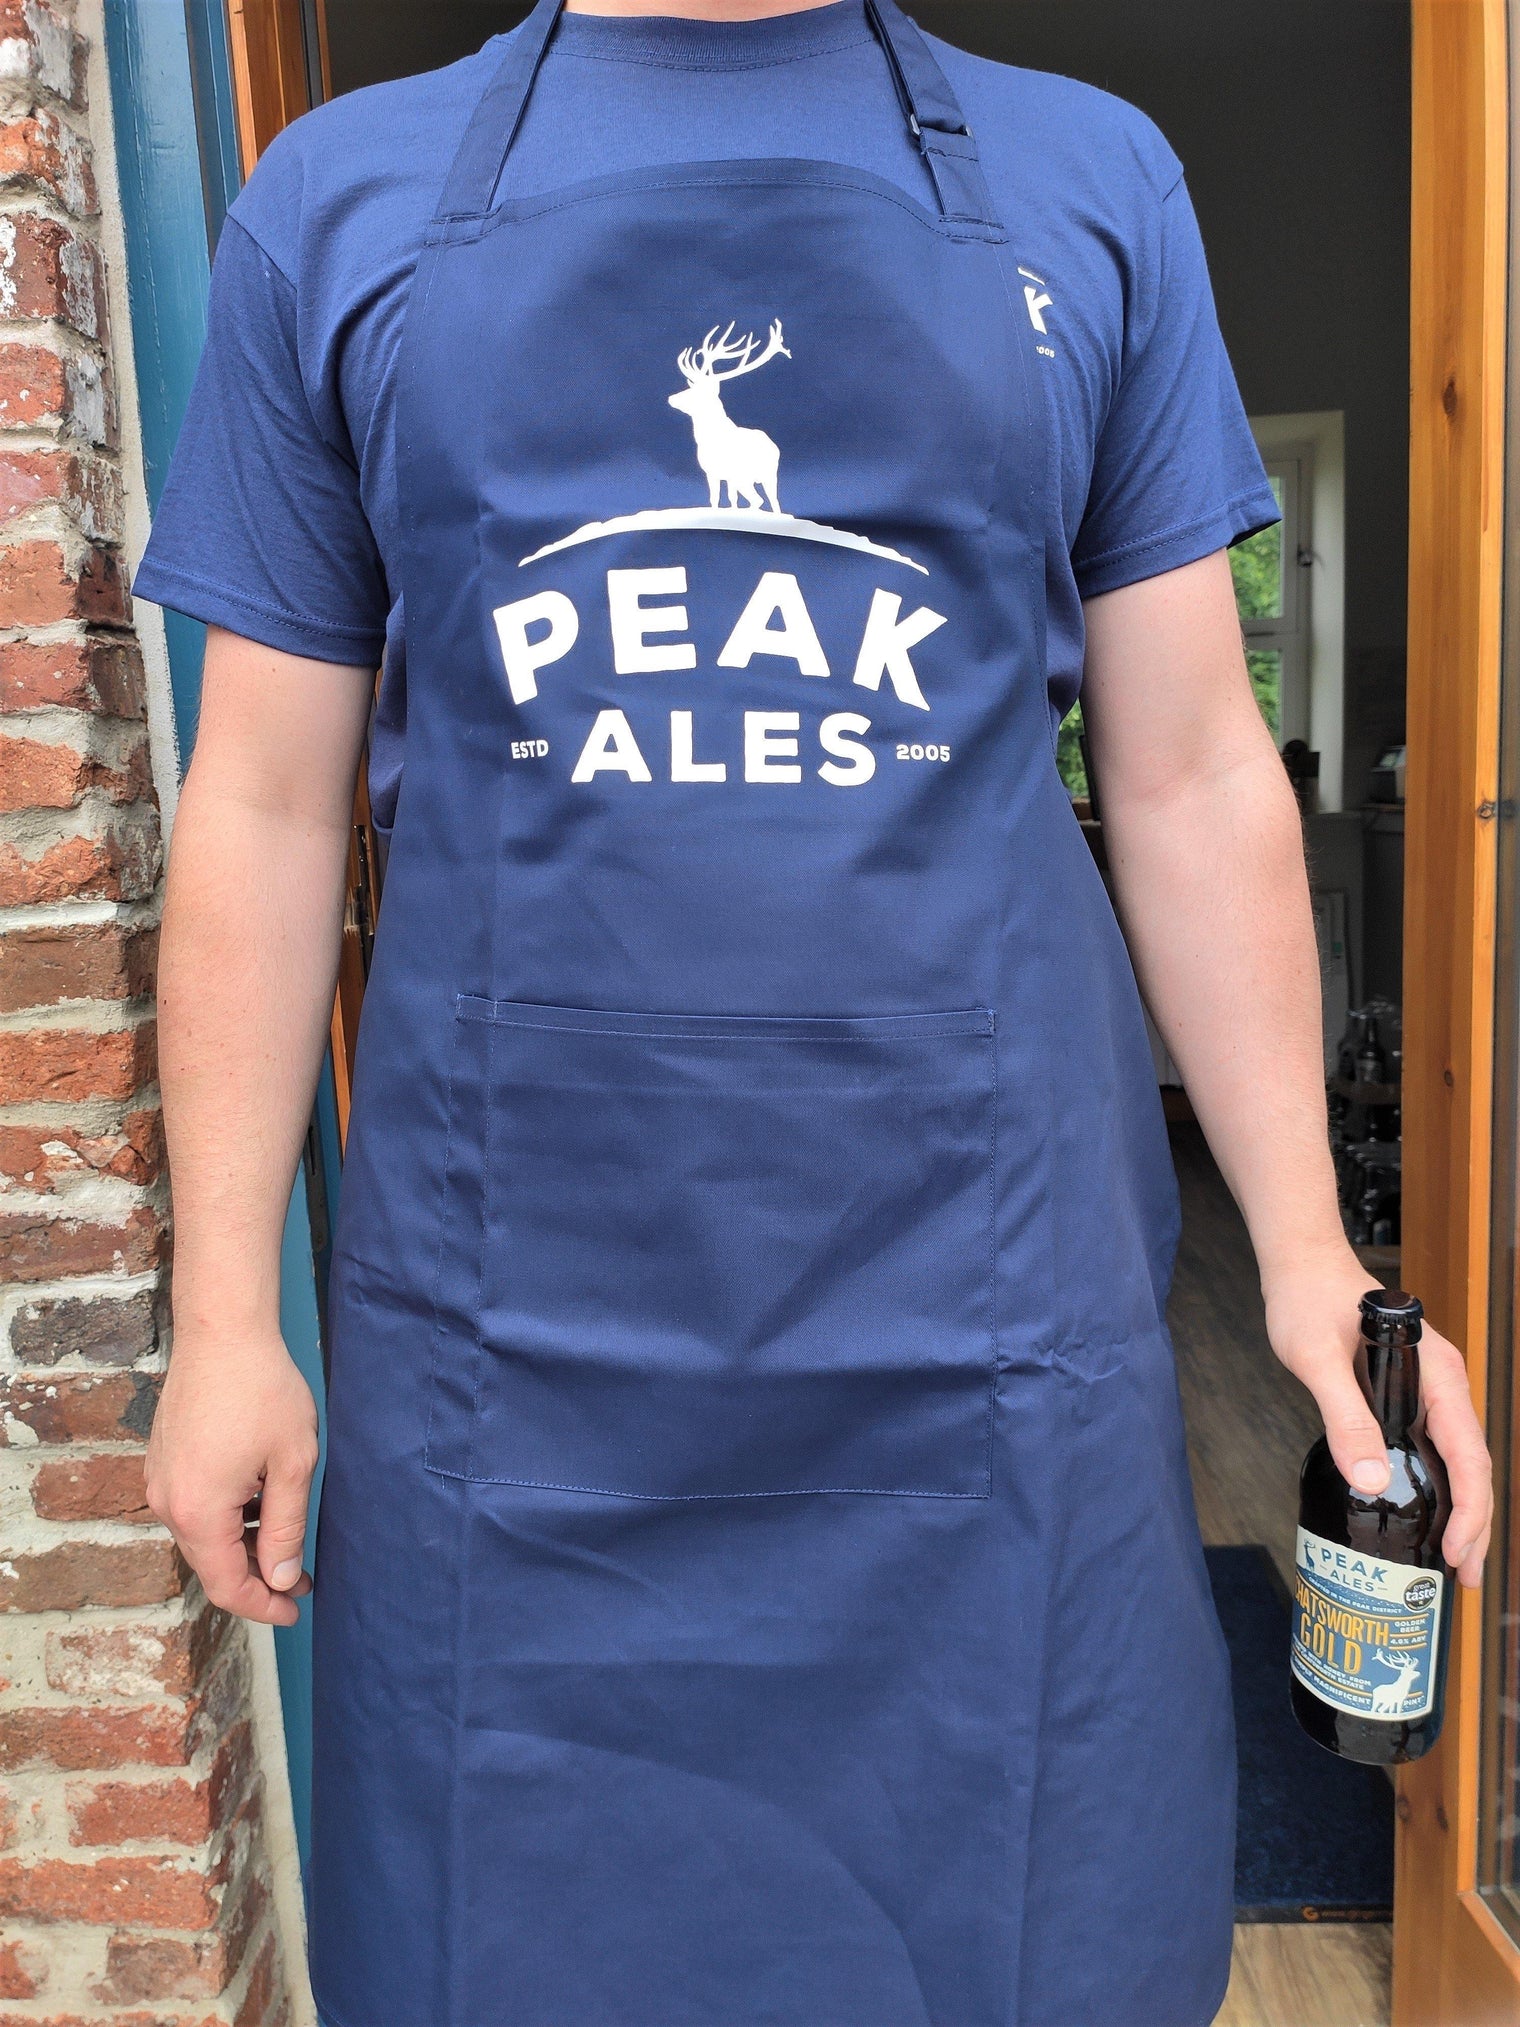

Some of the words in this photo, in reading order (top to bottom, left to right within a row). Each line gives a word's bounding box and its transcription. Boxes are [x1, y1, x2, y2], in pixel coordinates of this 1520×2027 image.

[493, 566, 948, 711] PEAK
[511, 741, 549, 760] ESTD
[571, 709, 876, 787] ALES
[896, 744, 951, 763] 2005
[1321, 1547, 1388, 1583] PEAK
[1330, 1570, 1374, 1592] ALES
[1405, 1587, 1436, 1602] taste
[1338, 1596, 1351, 1604] THE
[1352, 1601, 1371, 1610] PEAK
[1372, 1606, 1402, 1614] DISTRICT
[1394, 1618, 1426, 1627] GOLDEN
[1400, 1625, 1421, 1633] BEER
[1301, 1612, 1362, 1675] GOLD
[1411, 1635, 1426, 1643] ABV
[1313, 1675, 1372, 1705] MAGNIFICENT
[1337, 1677, 1364, 1690] ESTATE
[1349, 1676, 1372, 1686] FROM
